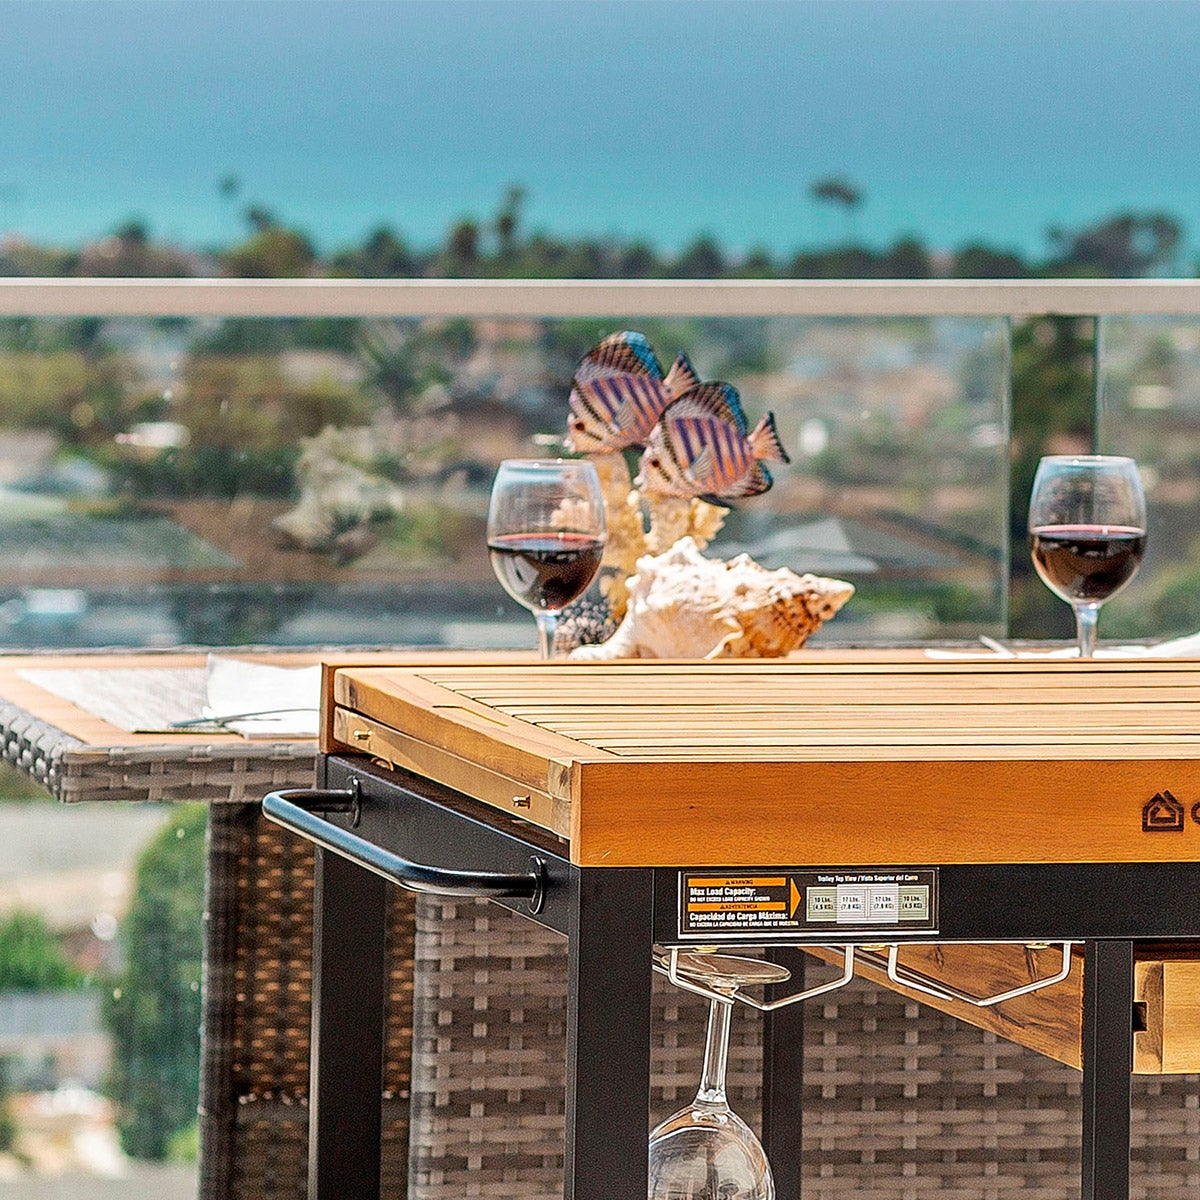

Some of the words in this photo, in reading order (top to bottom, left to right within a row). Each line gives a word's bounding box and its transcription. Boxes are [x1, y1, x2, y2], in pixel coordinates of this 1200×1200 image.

[690, 888, 705, 896] Max
[706, 887, 723, 896] Load
[724, 887, 756, 897] Capacity:
[689, 912, 726, 922] Capacidad
[736, 912, 757, 922] Carga
